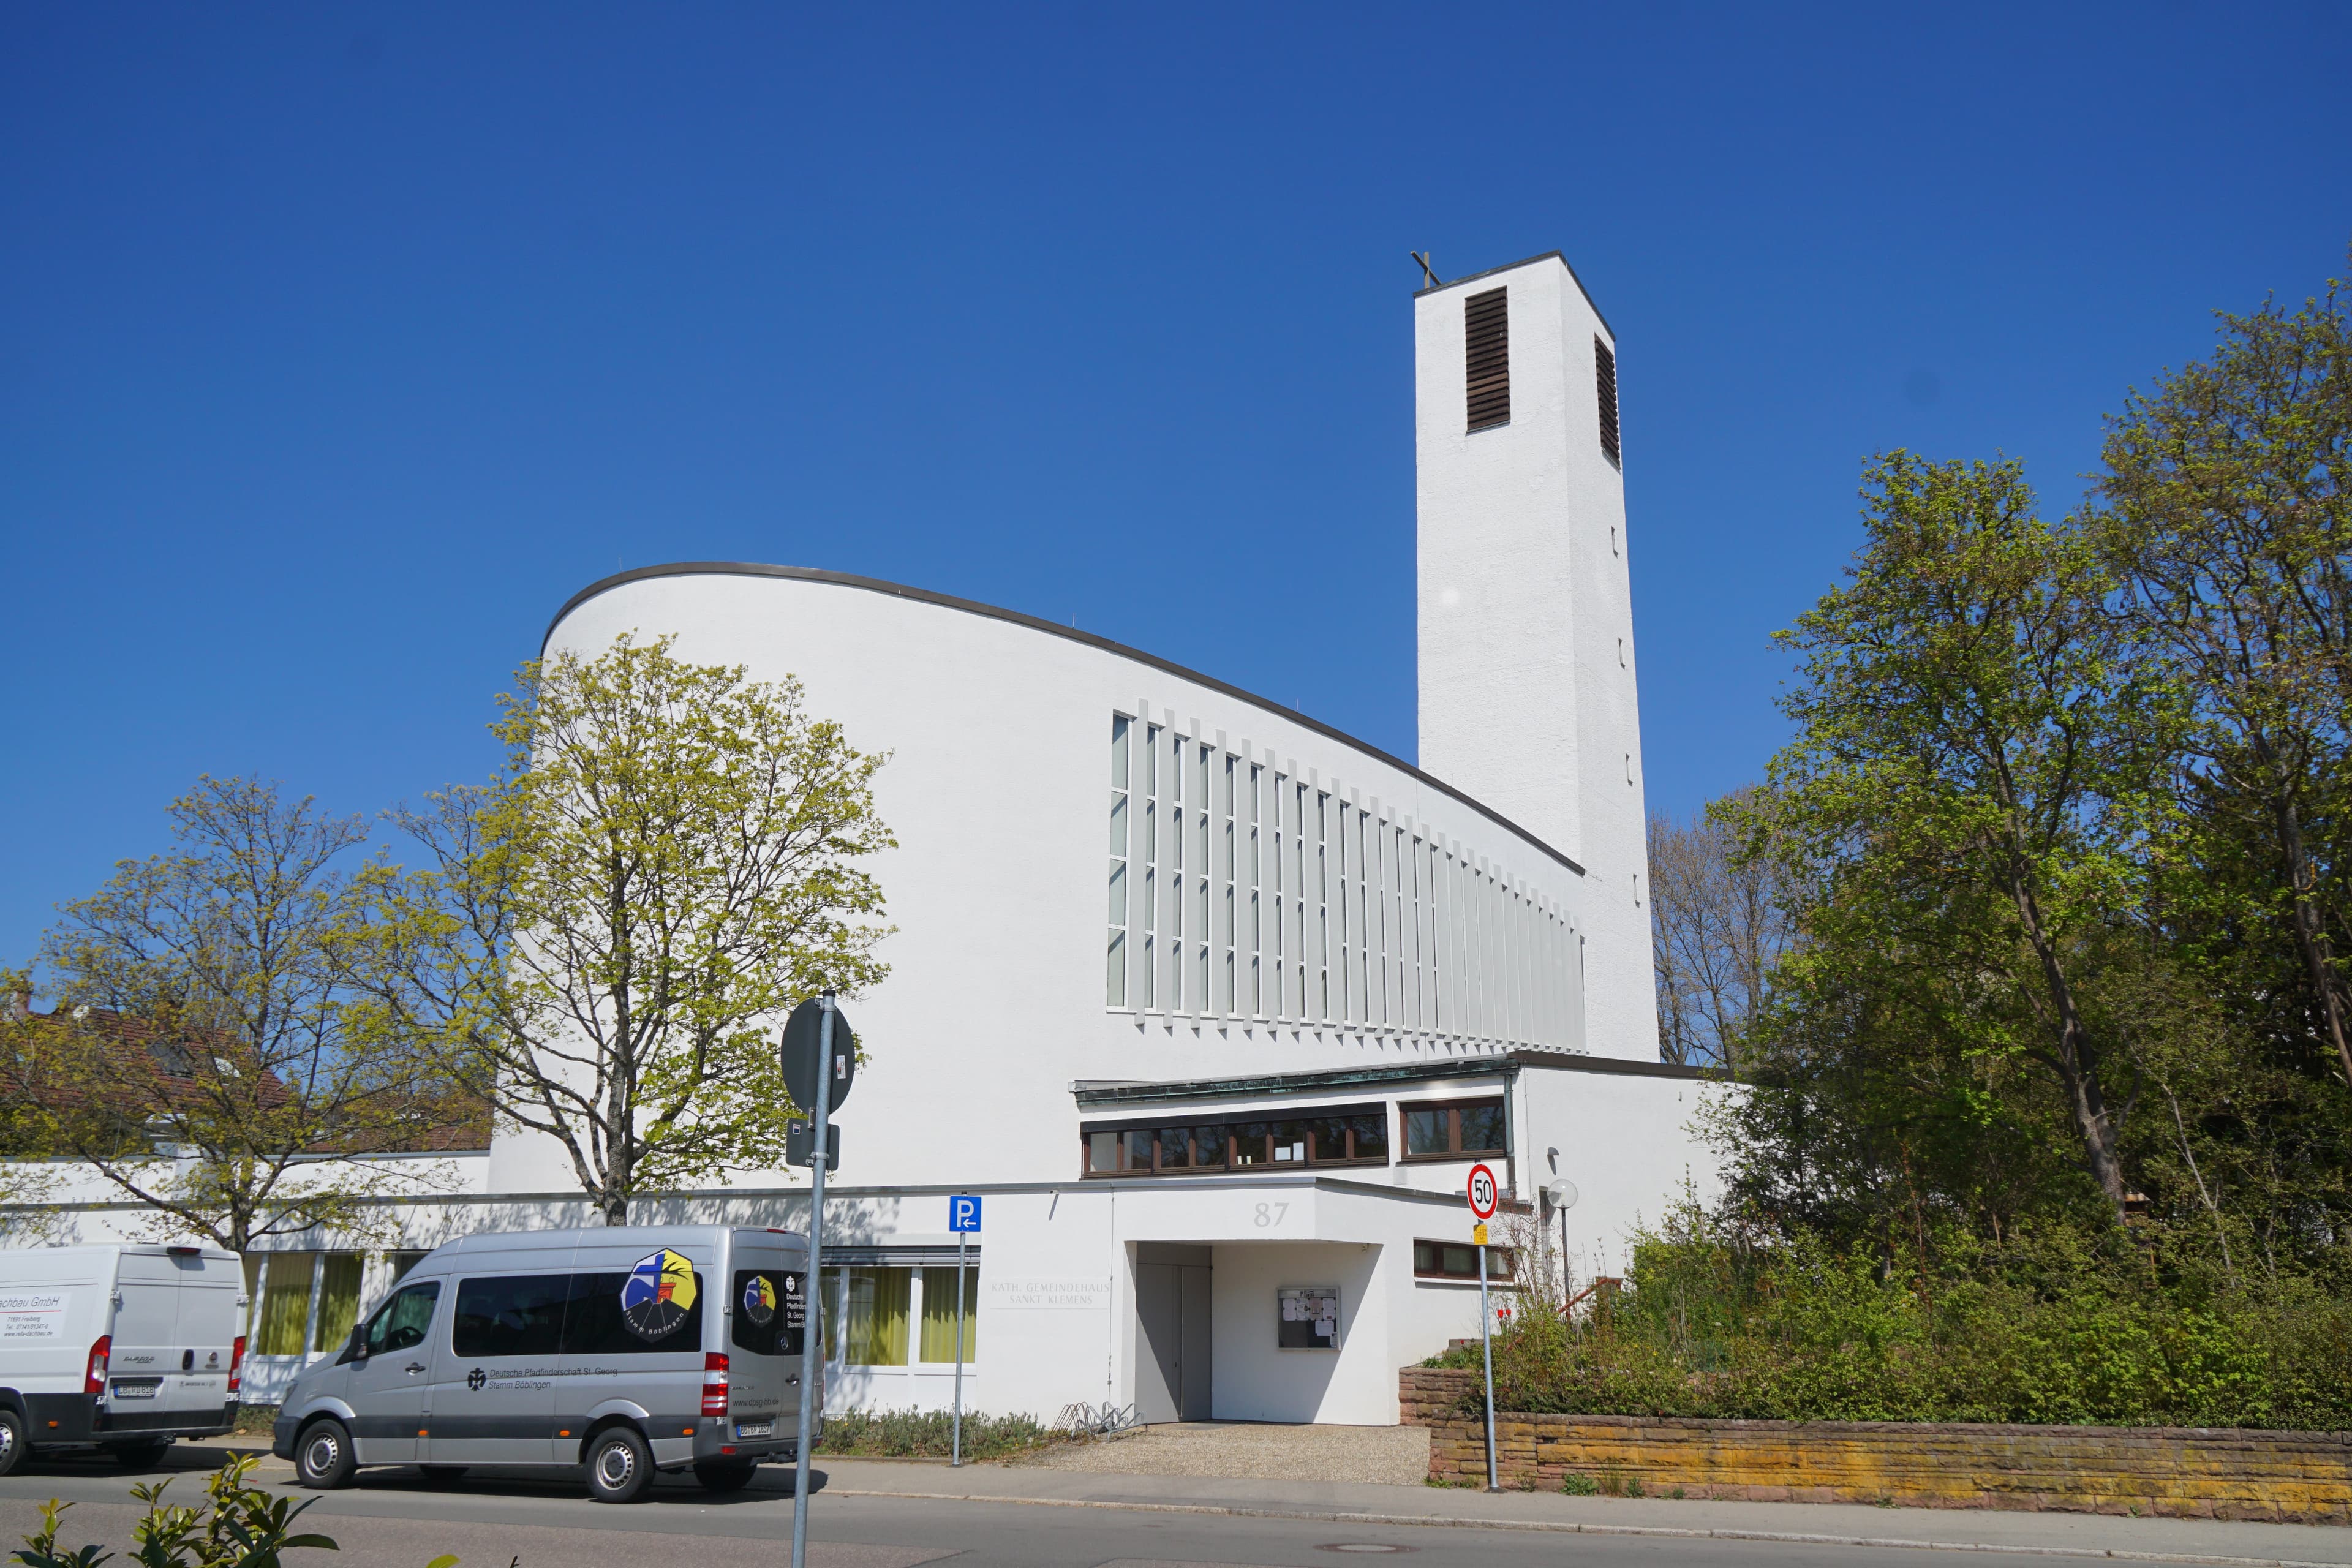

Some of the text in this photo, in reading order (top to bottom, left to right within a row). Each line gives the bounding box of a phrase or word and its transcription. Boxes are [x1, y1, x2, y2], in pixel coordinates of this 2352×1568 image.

[1474, 1179, 1491, 1204] 50
[957, 1200, 974, 1227] P
[1254, 1202, 1289, 1227] 87
[992, 1283, 1110, 1292] KATH. GEMEINDEHAUS
[31, 1296, 60, 1307] GmbH
[1009, 1295, 1093, 1305] SANKT KLEMENS
[626, 1310, 684, 1335] Stamm Böblingen
[490, 1367, 618, 1378] Deutsche Pfadfinderschaft St. Georg
[489, 1380, 551, 1390] Stamm Böblingen
[733, 1397, 779, 1408] www.dpsg-bb.de
